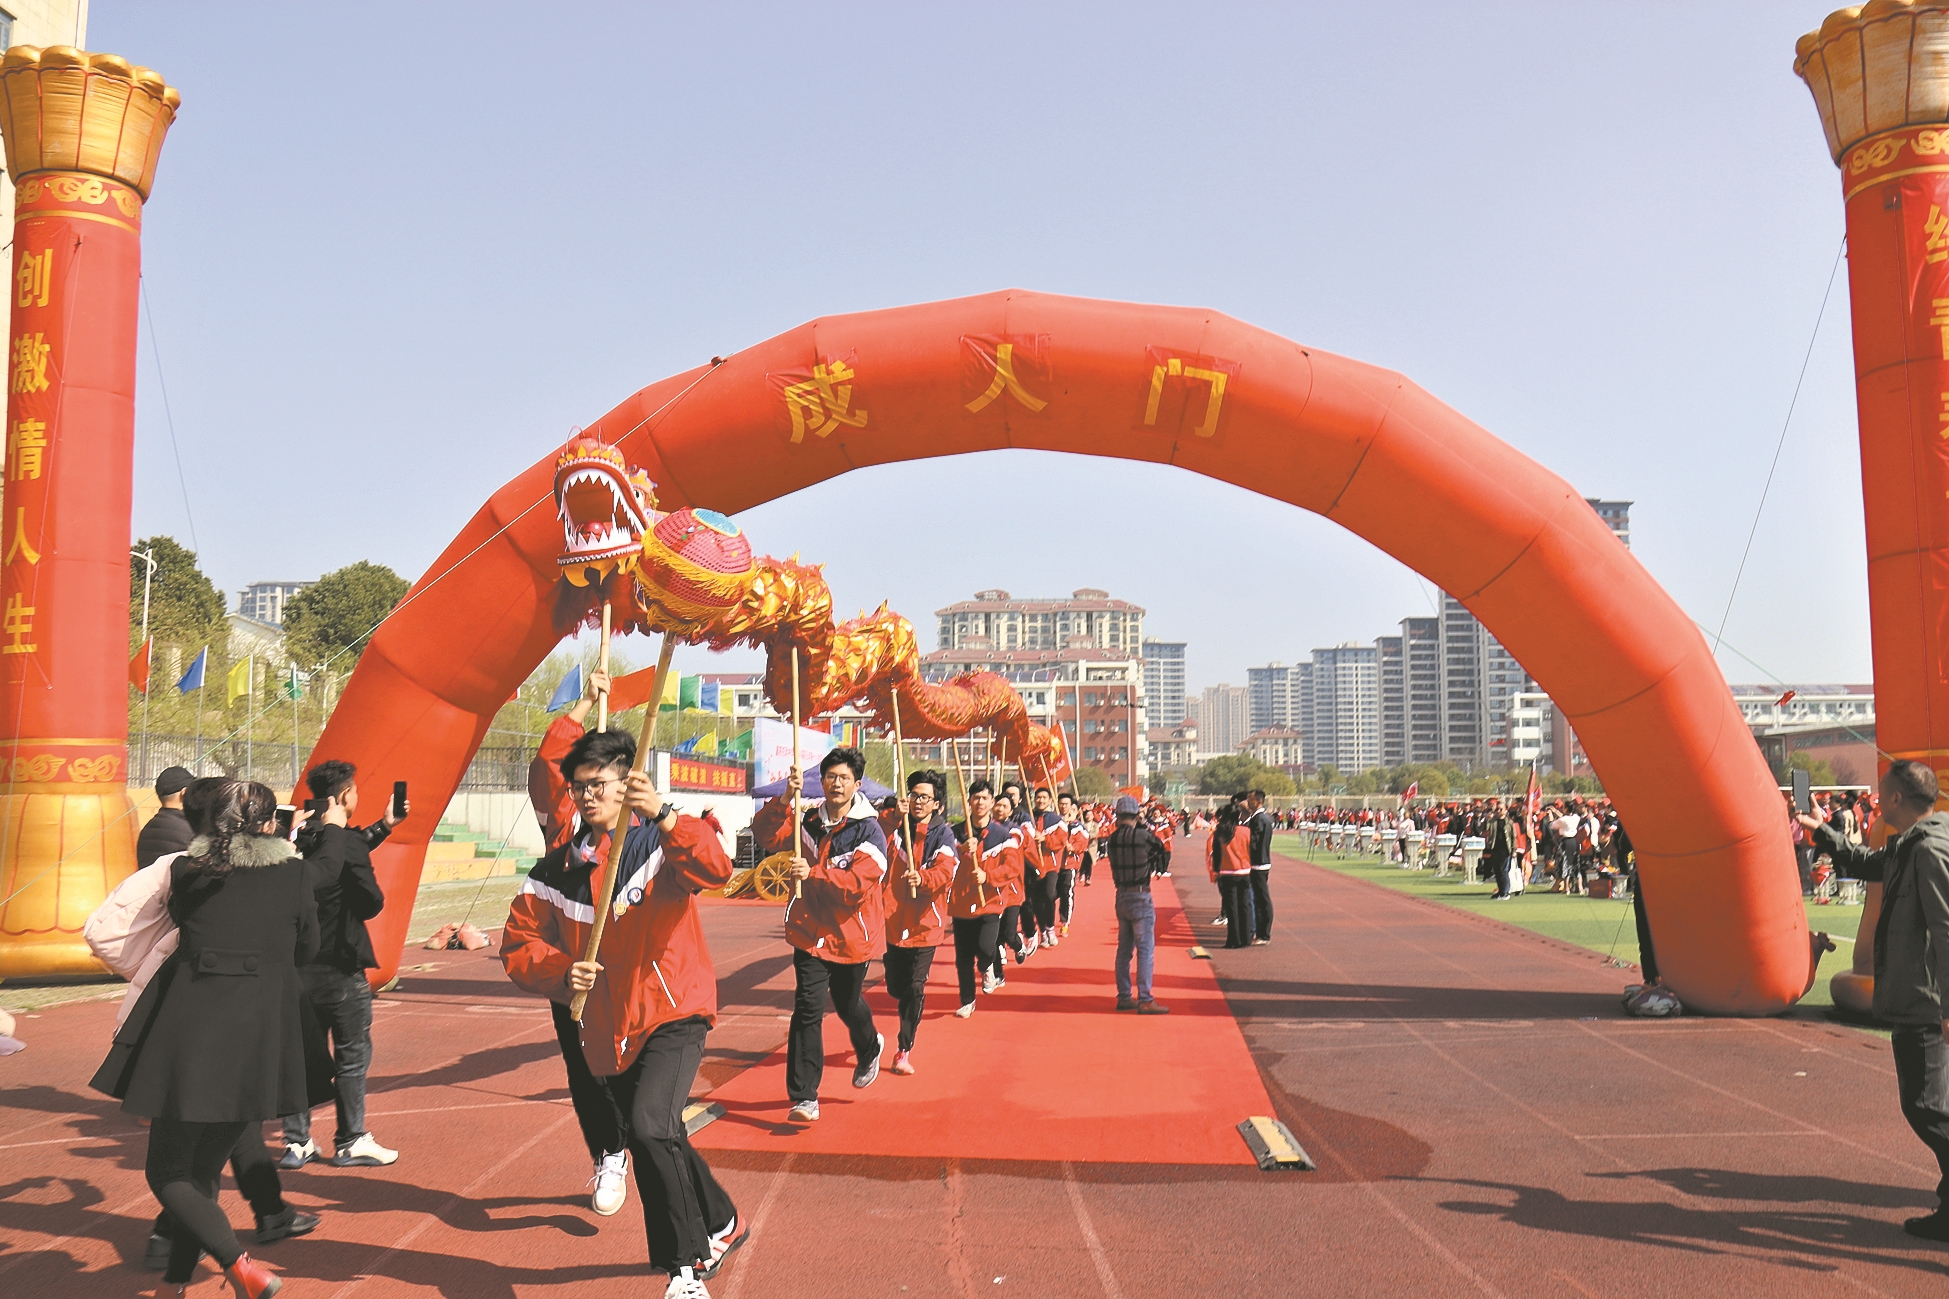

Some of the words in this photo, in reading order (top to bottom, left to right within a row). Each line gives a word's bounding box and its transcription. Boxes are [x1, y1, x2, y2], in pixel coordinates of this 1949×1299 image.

[2, 248, 53, 656] 创激情人生
[783, 343, 1229, 444] 成人门
